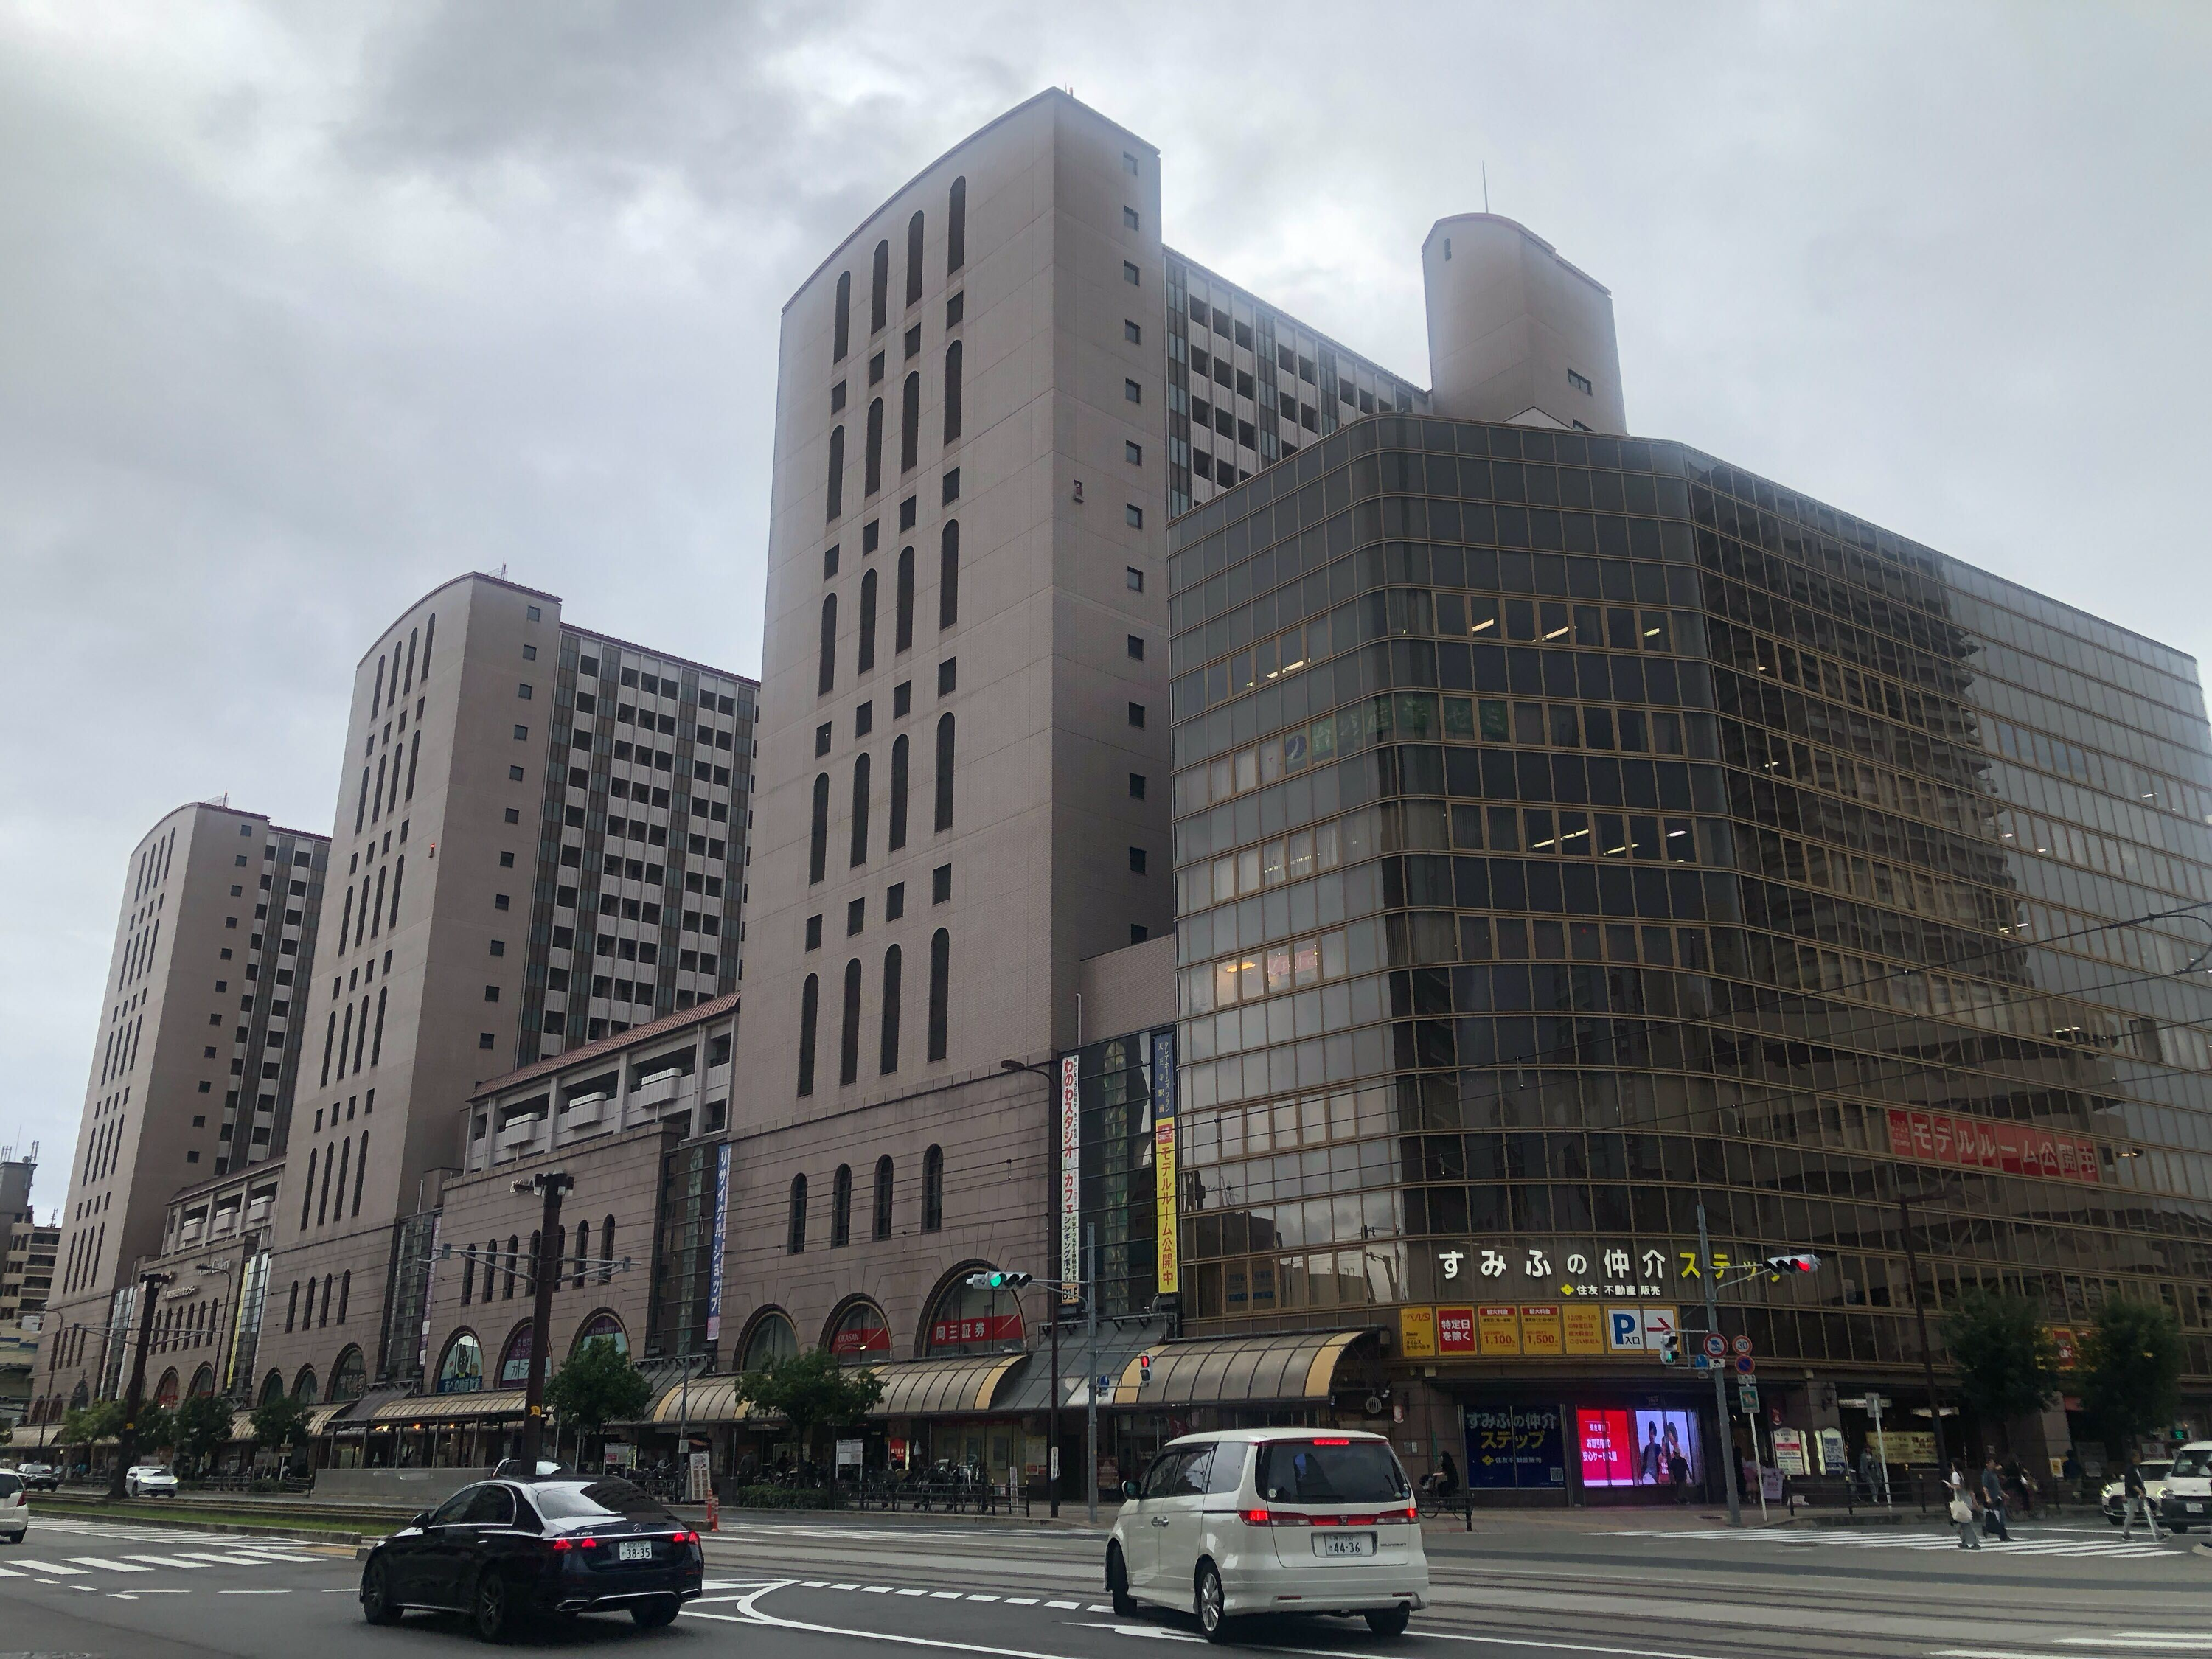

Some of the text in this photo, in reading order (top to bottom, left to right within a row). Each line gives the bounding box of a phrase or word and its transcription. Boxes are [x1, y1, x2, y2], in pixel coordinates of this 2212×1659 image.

[1913, 1122, 2096, 1173] モデルルーム公開中
[1160, 1147, 1174, 1286] モデルルーム公開中
[710, 1151, 727, 1312] リサイクルショップ
[1439, 1249, 1666, 1279] すみふの仲介
[936, 1323, 985, 1340] 岡三証券
[1441, 1319, 1470, 1330] 特定日
[1613, 1313, 1635, 1344] P
[1442, 1331, 1470, 1341] を除く
[1484, 1335, 1512, 1345] 1,100
[1527, 1335, 1555, 1345] 1,500
[1737, 1341, 1748, 1350] 30
[1466, 1412, 1557, 1430] すみふの仲介
[1481, 1430, 1545, 1450] ステップ
[627, 1548, 650, 1559] 38-35
[1333, 1542, 1360, 1554] 44-36
